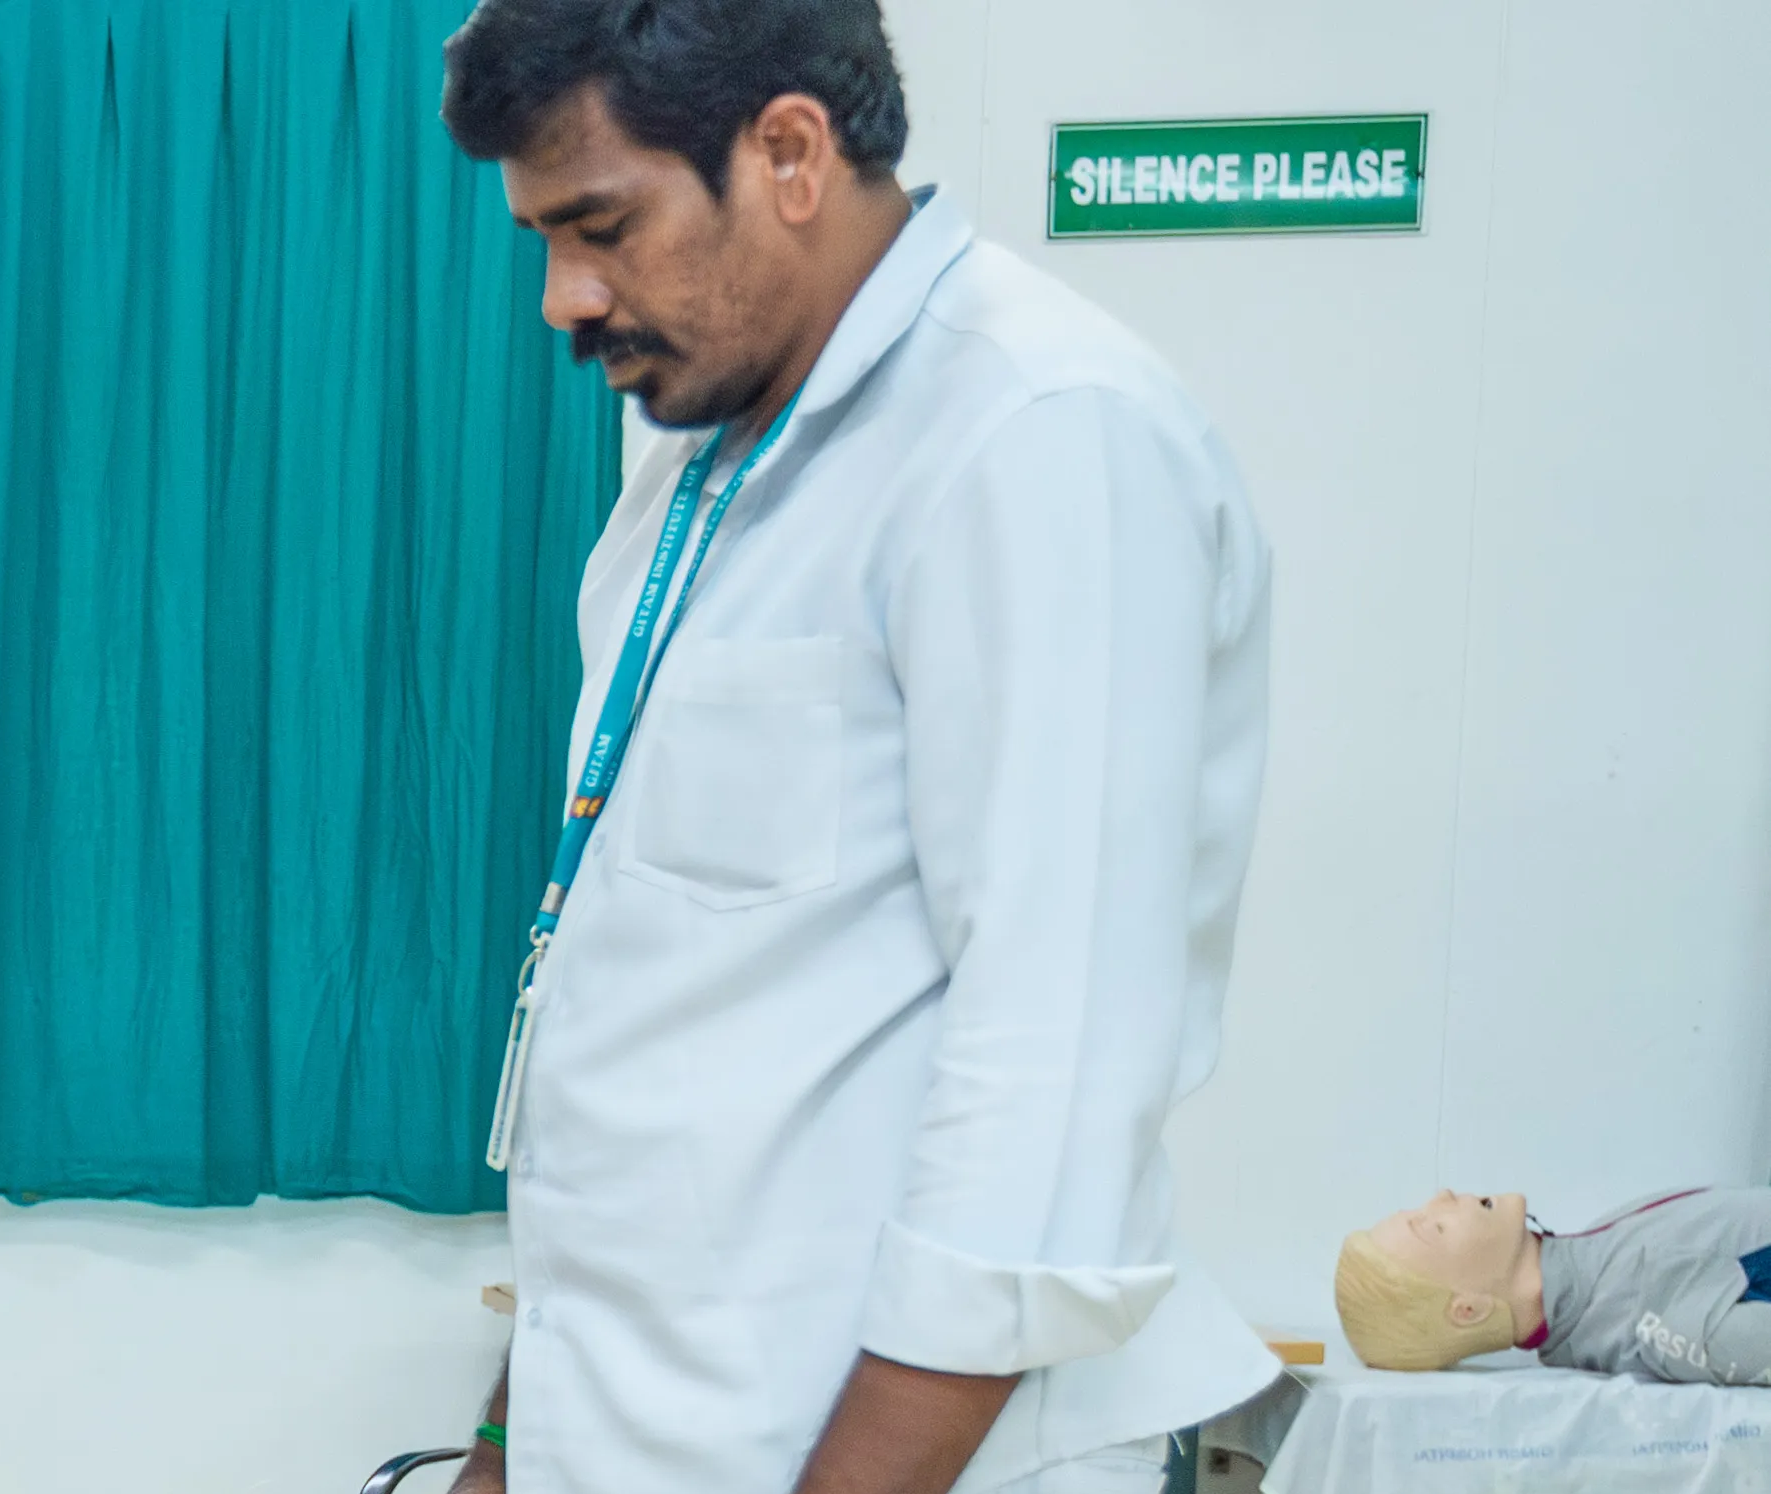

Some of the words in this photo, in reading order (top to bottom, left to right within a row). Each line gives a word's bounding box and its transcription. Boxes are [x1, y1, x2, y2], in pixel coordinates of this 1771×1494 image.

[1068, 152, 1242, 206] SILENCE
[1252, 147, 1407, 200] PLEASE
[632, 583, 660, 638] GITAM
[651, 490, 690, 578] INSTITUTE
[584, 733, 612, 788] GITAM
